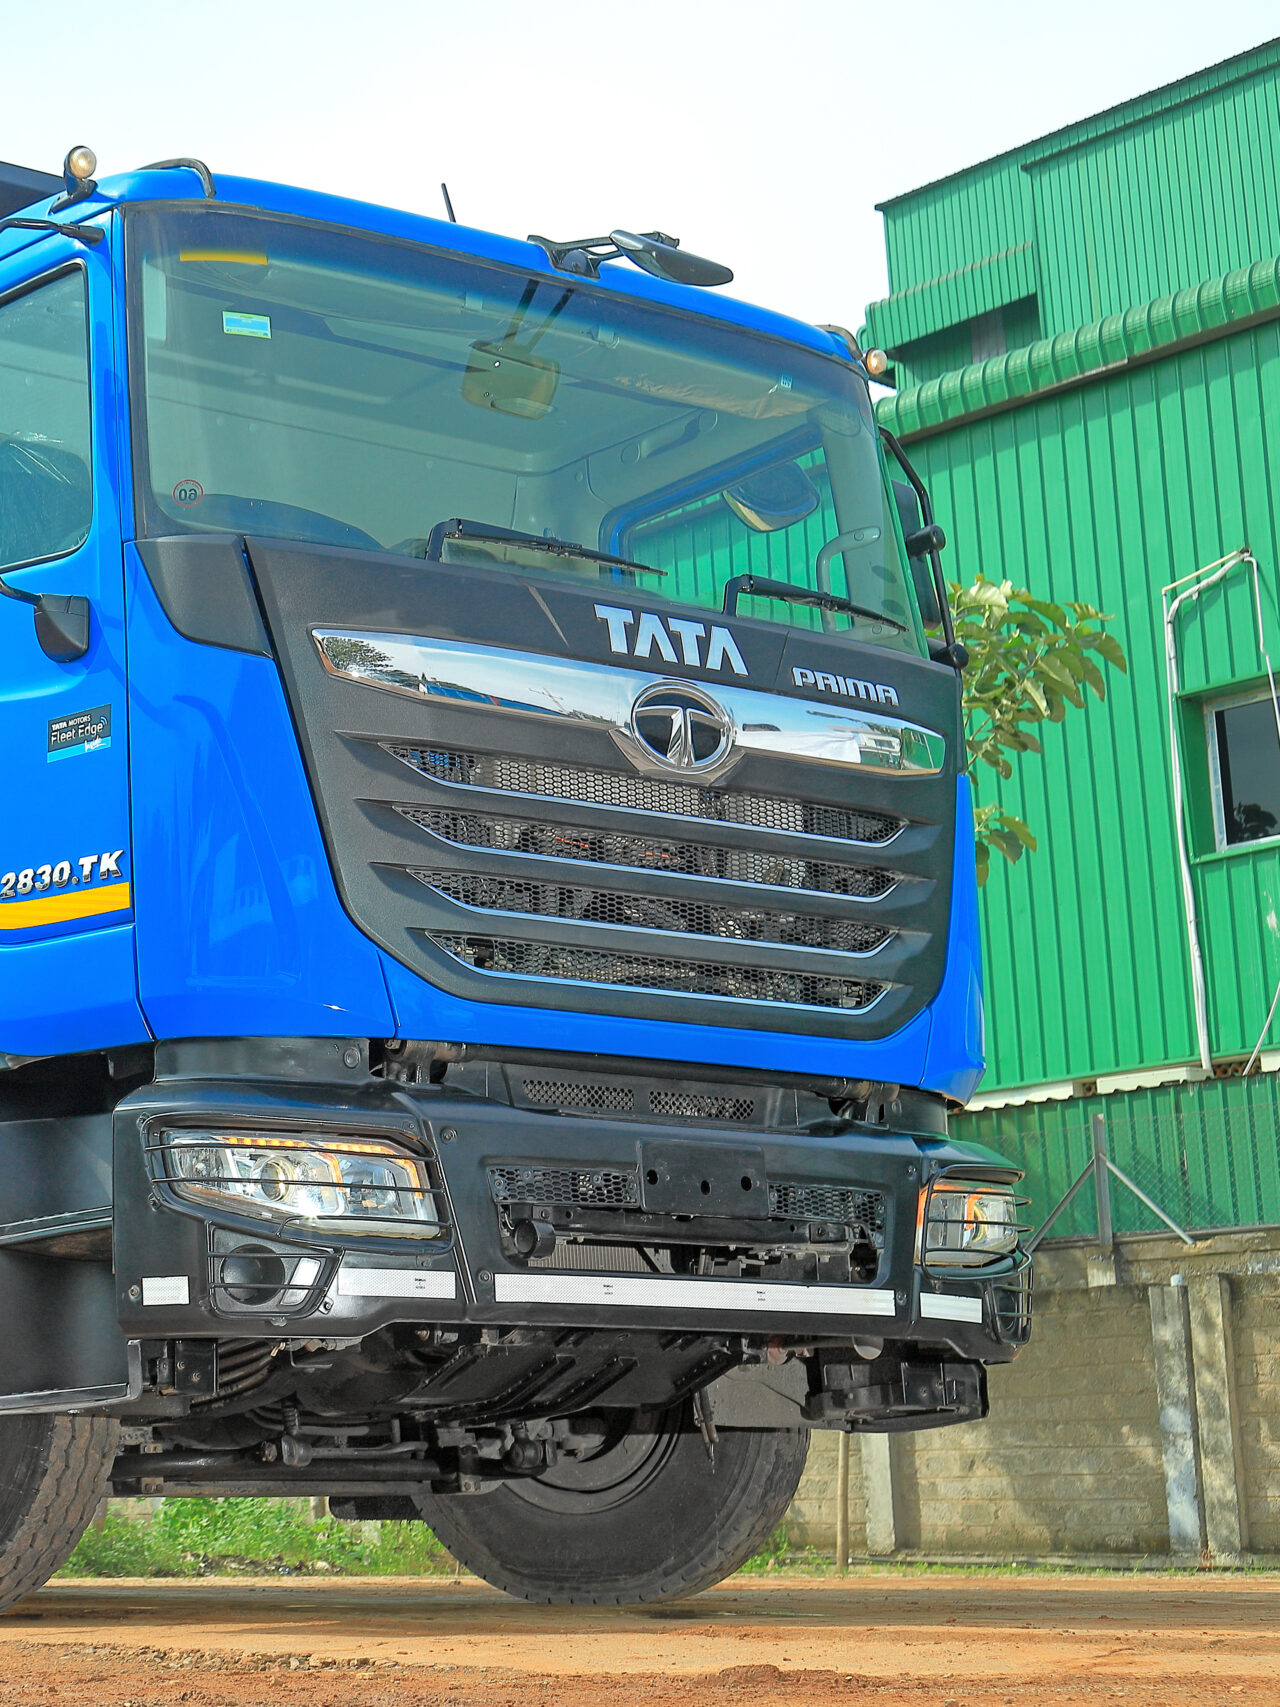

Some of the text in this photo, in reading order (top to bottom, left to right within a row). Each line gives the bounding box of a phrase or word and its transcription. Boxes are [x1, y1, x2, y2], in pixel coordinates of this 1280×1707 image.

[593, 603, 749, 677] TATA
[792, 666, 900, 706] PRIMA
[51, 714, 91, 731] TATA MOTORS
[51, 722, 103, 745] Fleet Edge
[0, 849, 124, 899] 2830.TK
